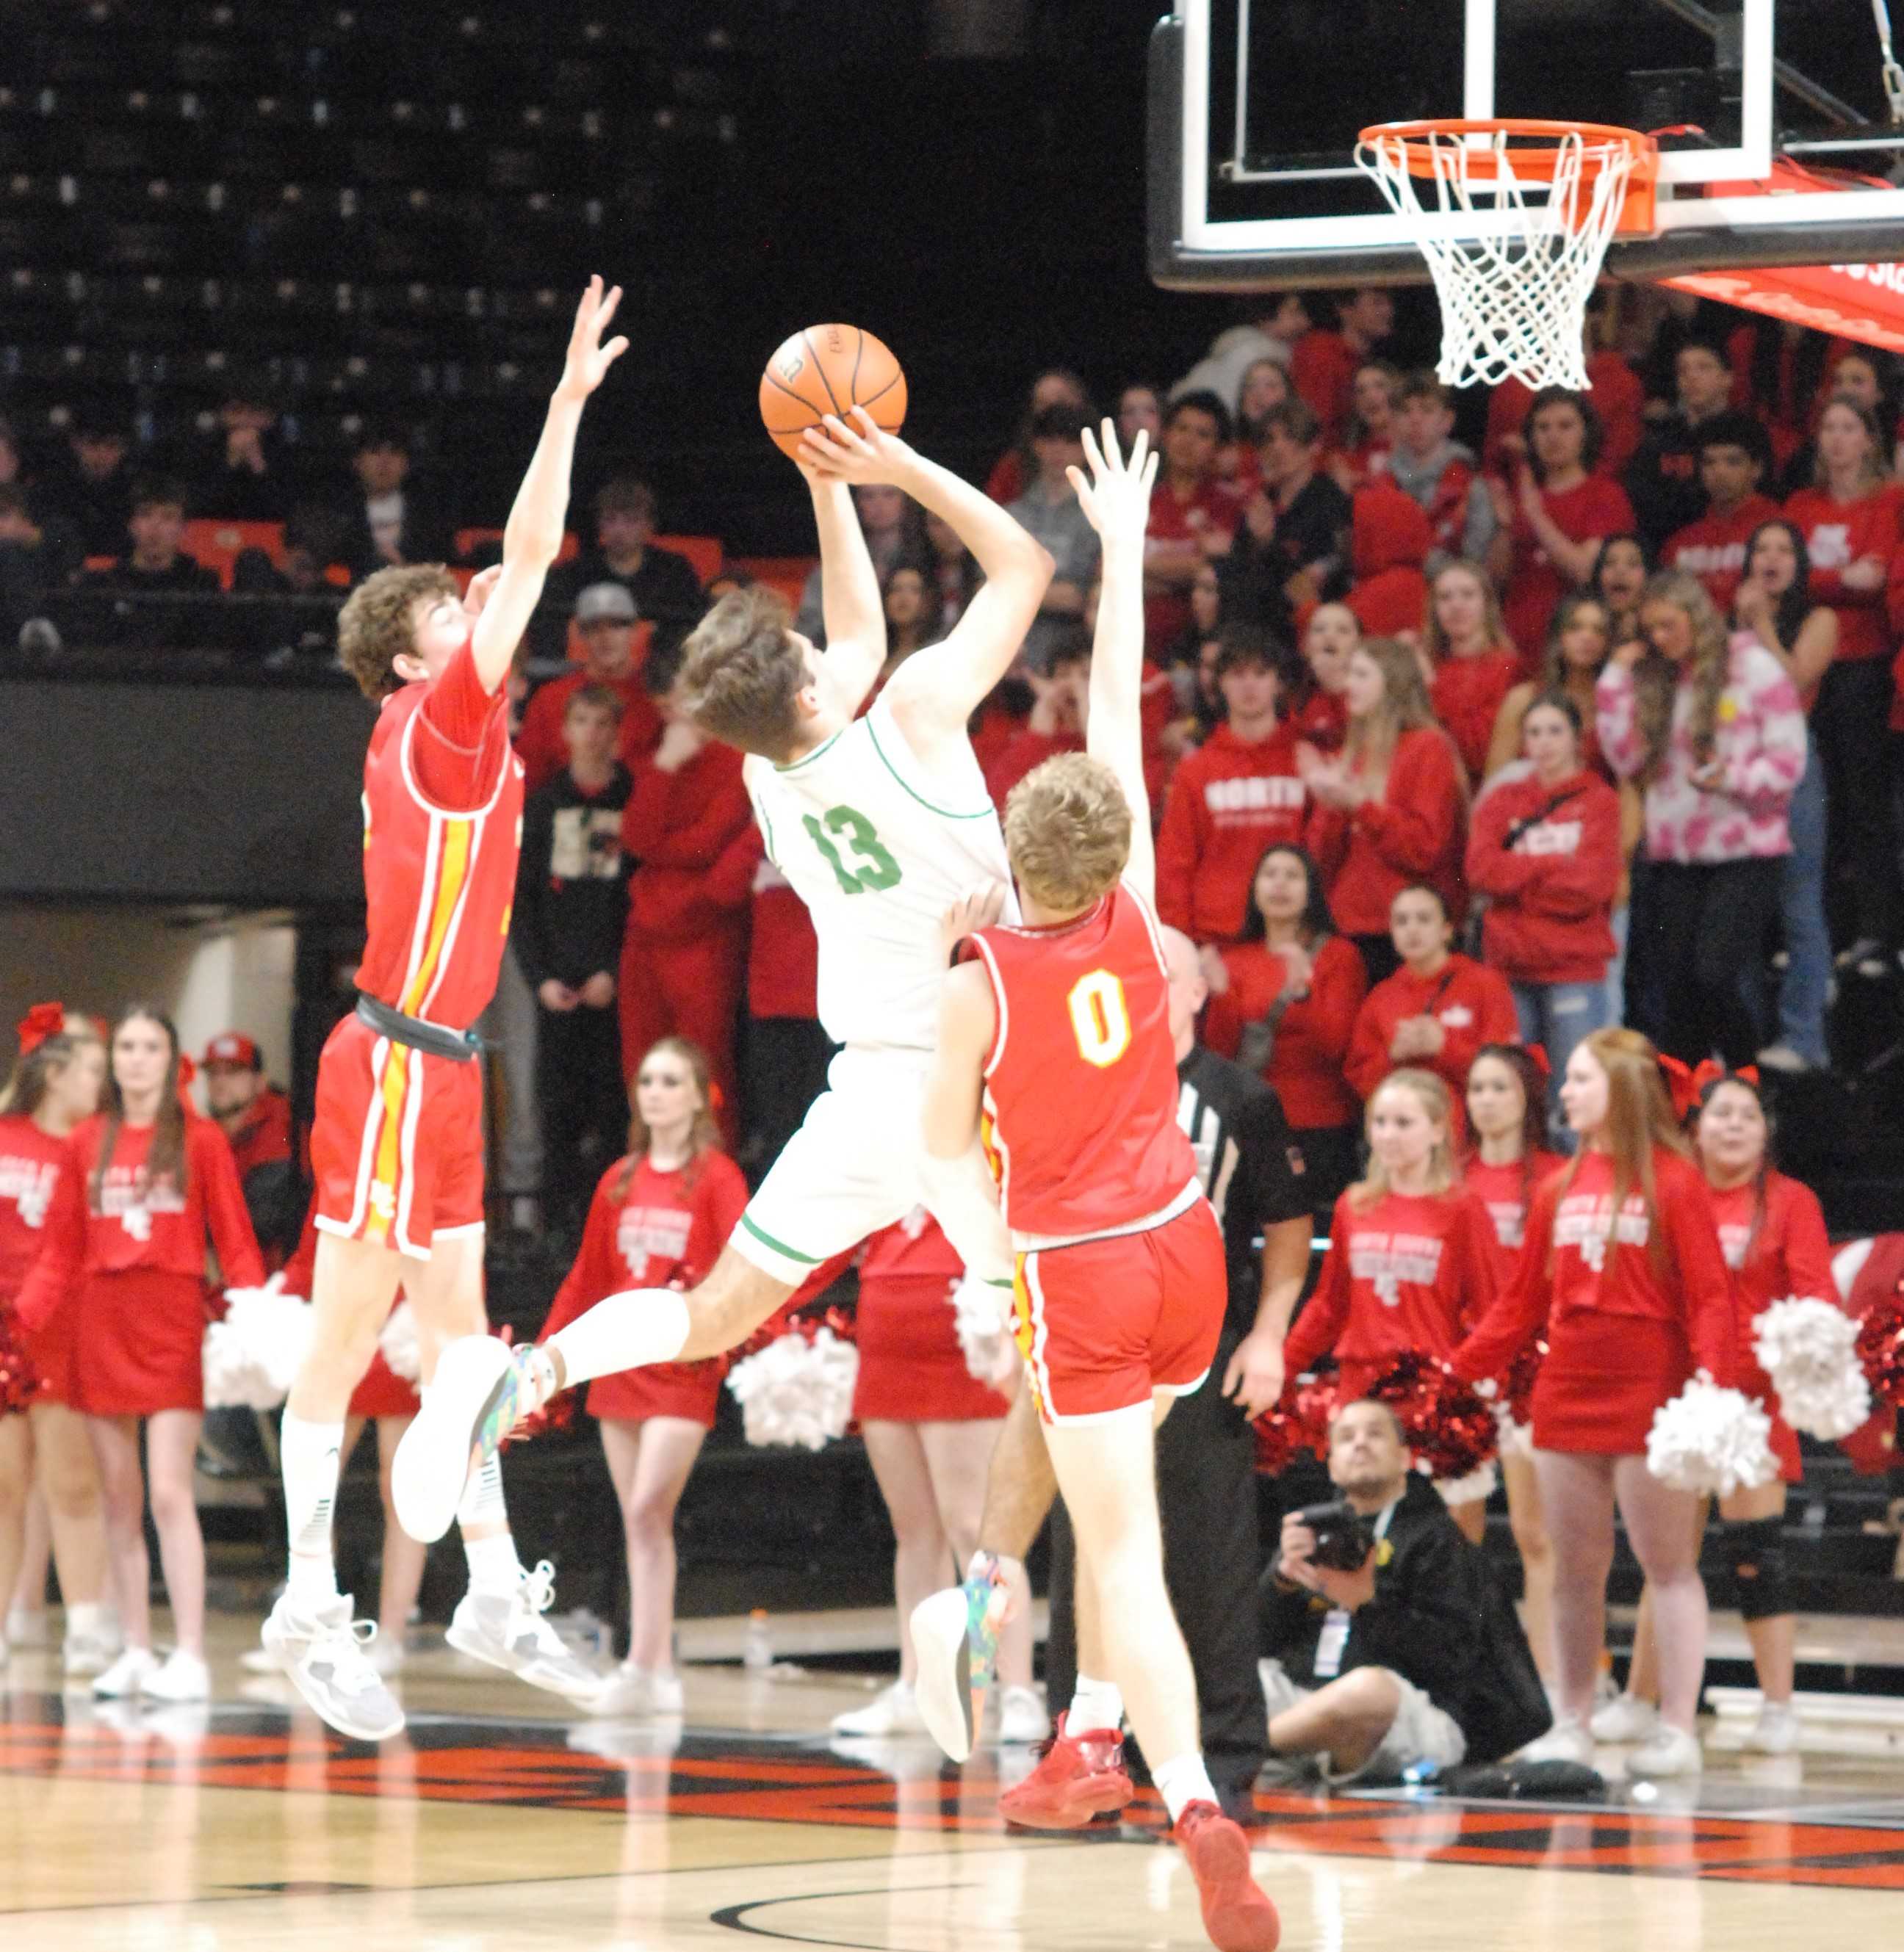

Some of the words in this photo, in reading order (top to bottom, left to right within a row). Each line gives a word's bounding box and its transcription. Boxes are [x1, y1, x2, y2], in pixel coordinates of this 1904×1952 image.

[1205, 776, 1305, 811] NORTH
[801, 804, 903, 894] 13
[1067, 967, 1133, 1069] 0
